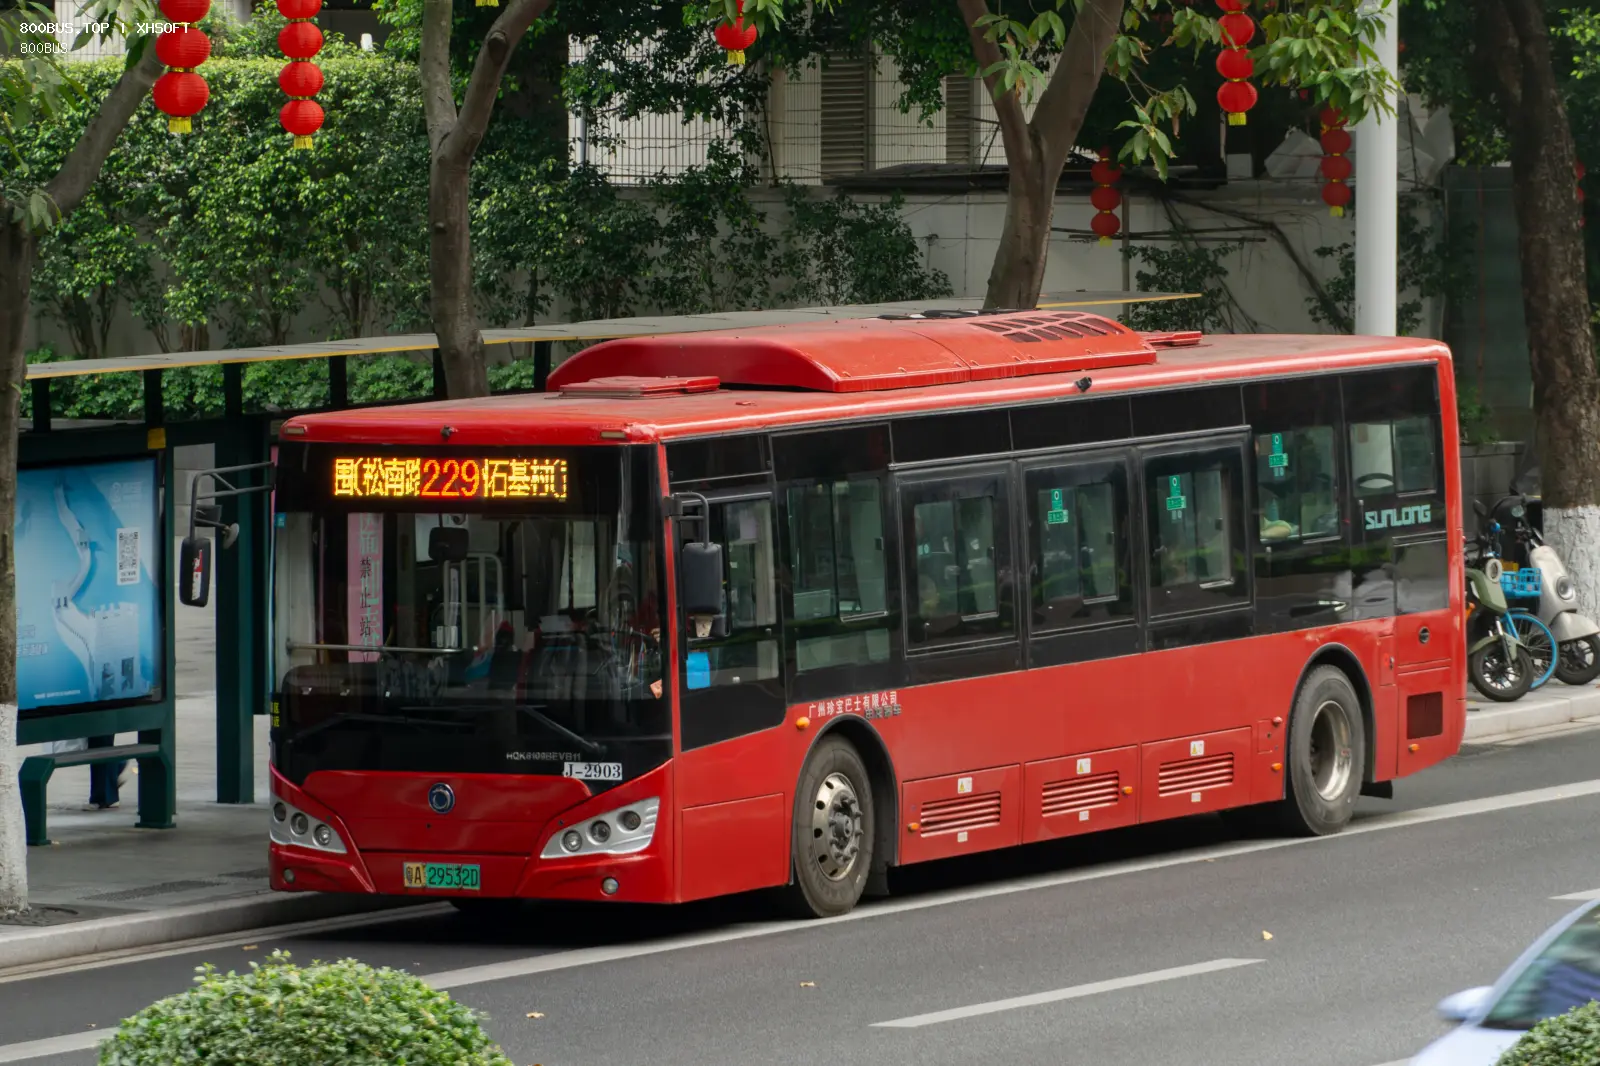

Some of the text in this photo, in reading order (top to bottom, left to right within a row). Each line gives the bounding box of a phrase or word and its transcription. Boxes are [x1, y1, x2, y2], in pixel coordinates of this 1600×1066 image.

[422, 459, 479, 496] 229
[1365, 504, 1432, 530] SUNLONG
[808, 690, 898, 718] 广州珍宝巴士有限公司
[565, 763, 622, 779] J-2903
